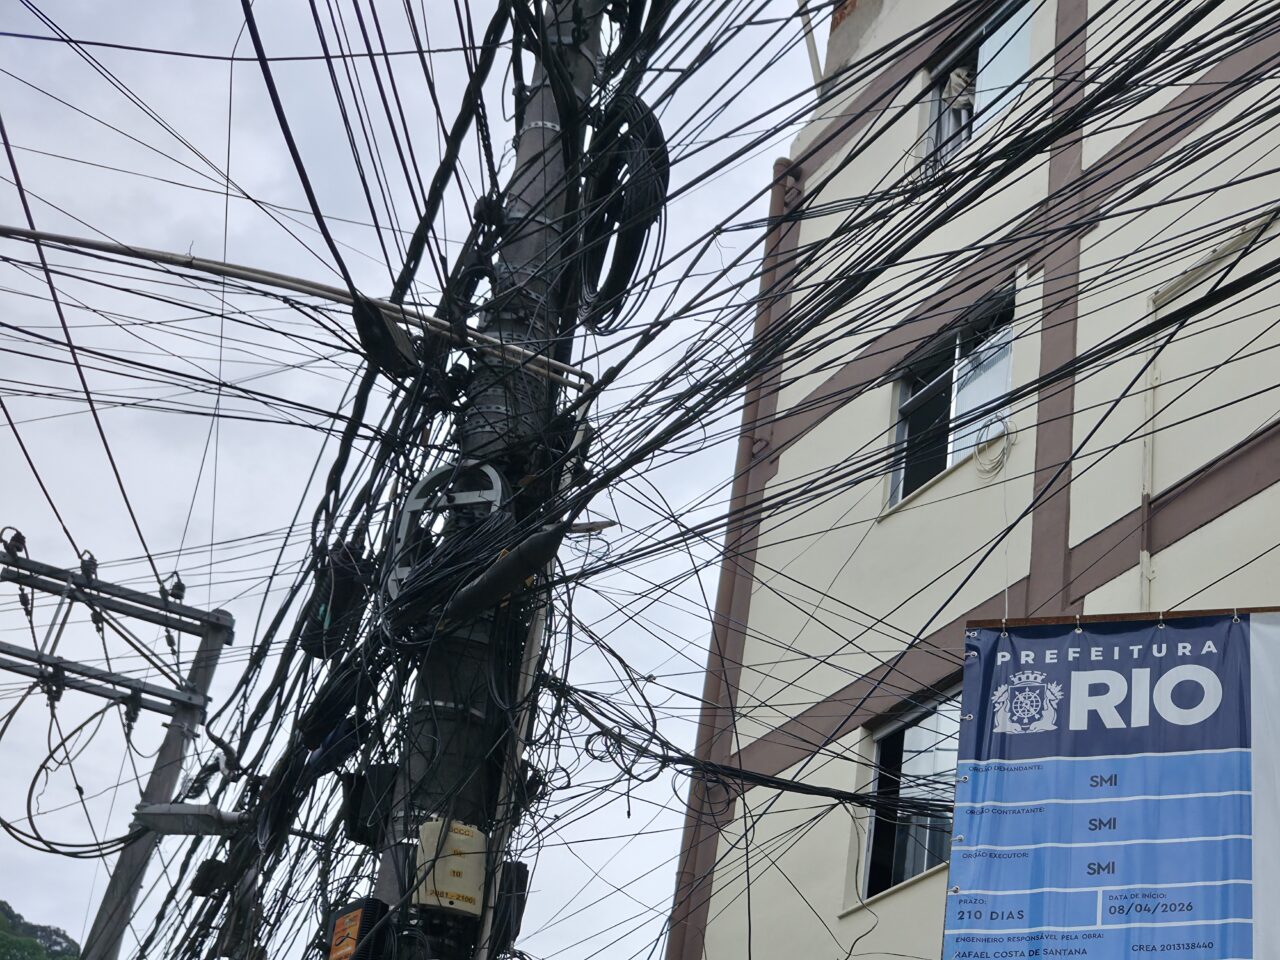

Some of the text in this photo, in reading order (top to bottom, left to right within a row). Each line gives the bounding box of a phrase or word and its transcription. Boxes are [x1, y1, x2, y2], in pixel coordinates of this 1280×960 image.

[996, 640, 1218, 665] PREFEITURA
[1068, 664, 1223, 731] RIO
[994, 764, 1043, 773] DEMANDANTE:
[1089, 774, 1118, 788] SMI
[991, 807, 1045, 815] CONTRATANTE:
[1088, 817, 1117, 831] SMI
[989, 851, 1029, 859] EXECUTOR:
[1086, 861, 1115, 875] SMI
[1109, 893, 1128, 901] DATA
[1108, 902, 1193, 915] 08/04/2026
[957, 910, 1025, 921] 210 DIAS
[1007, 933, 1057, 943] RESPONSÁVEL
[1061, 933, 1079, 941] PELA
[1131, 943, 1157, 952] CREA
[954, 948, 1088, 960] RAFAEL COSTA DE SANTANA
